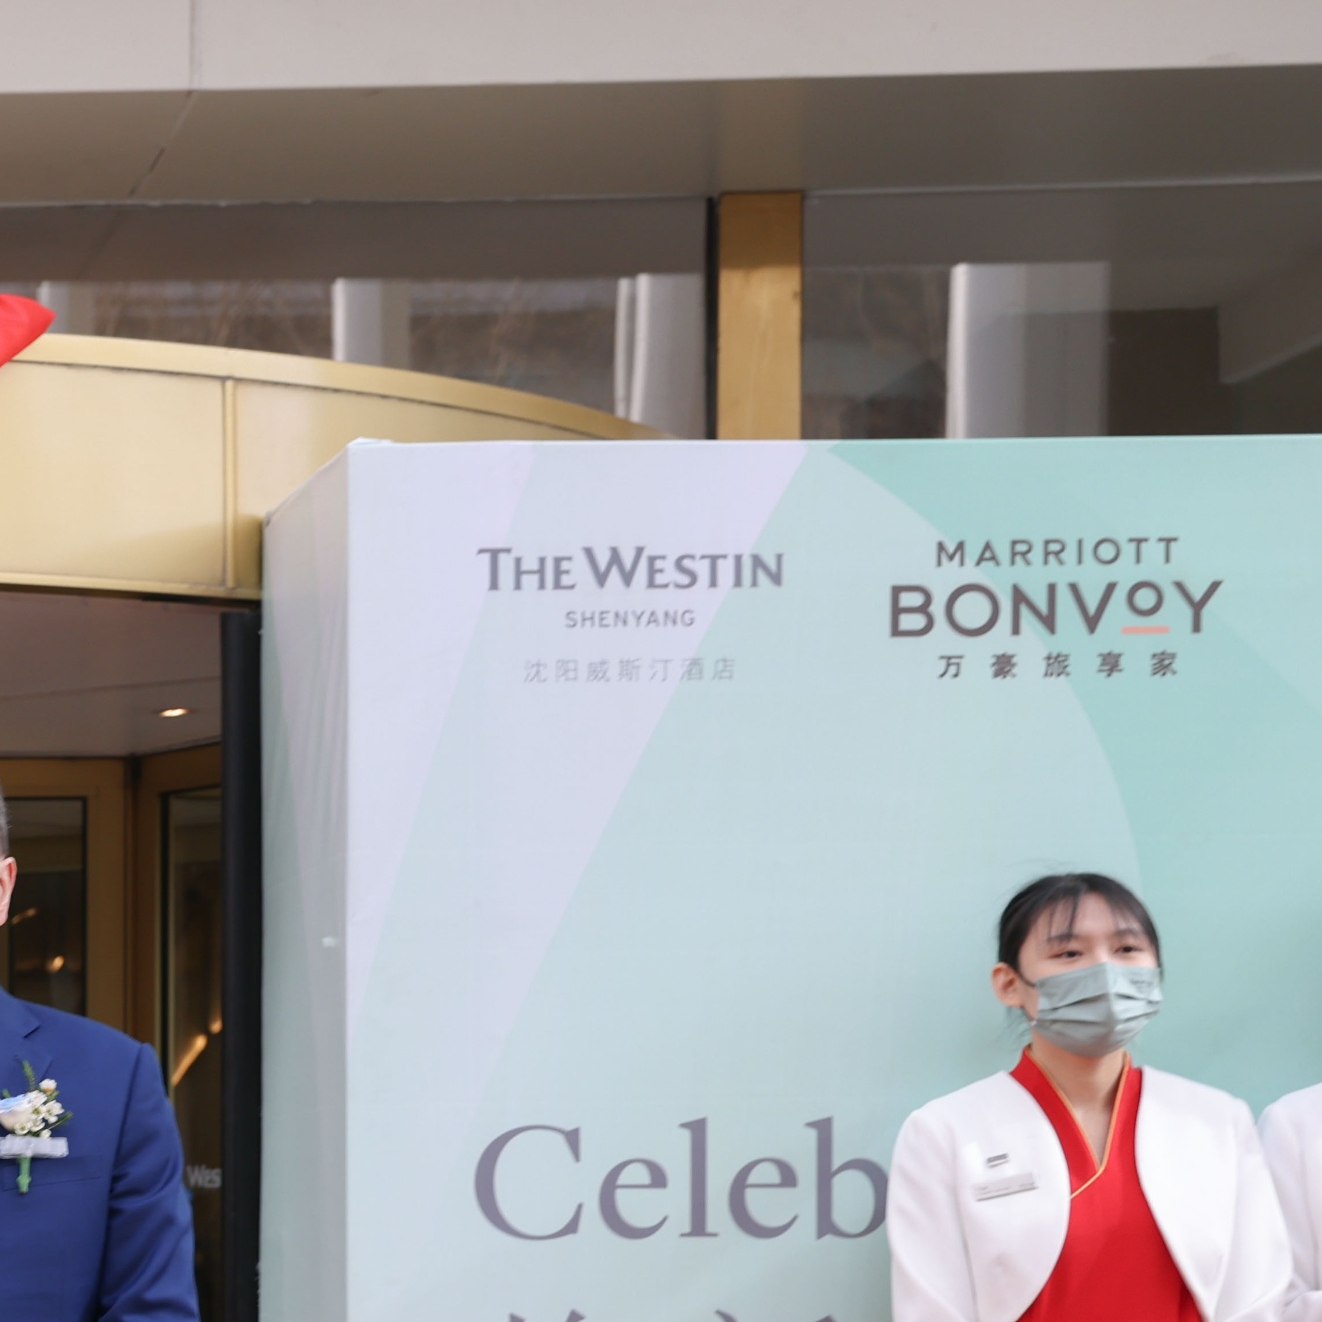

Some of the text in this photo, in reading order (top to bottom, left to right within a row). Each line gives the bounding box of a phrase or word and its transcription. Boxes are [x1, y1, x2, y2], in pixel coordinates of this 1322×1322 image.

[476, 545, 784, 591] THE WESTIN
[935, 536, 1180, 568] MARRIOTT
[564, 608, 696, 630] SHENYANG
[888, 579, 1225, 639] BONVOY
[523, 656, 736, 684] 沈阳威斯汀酒店
[937, 649, 1179, 681] 万豪旅享家
